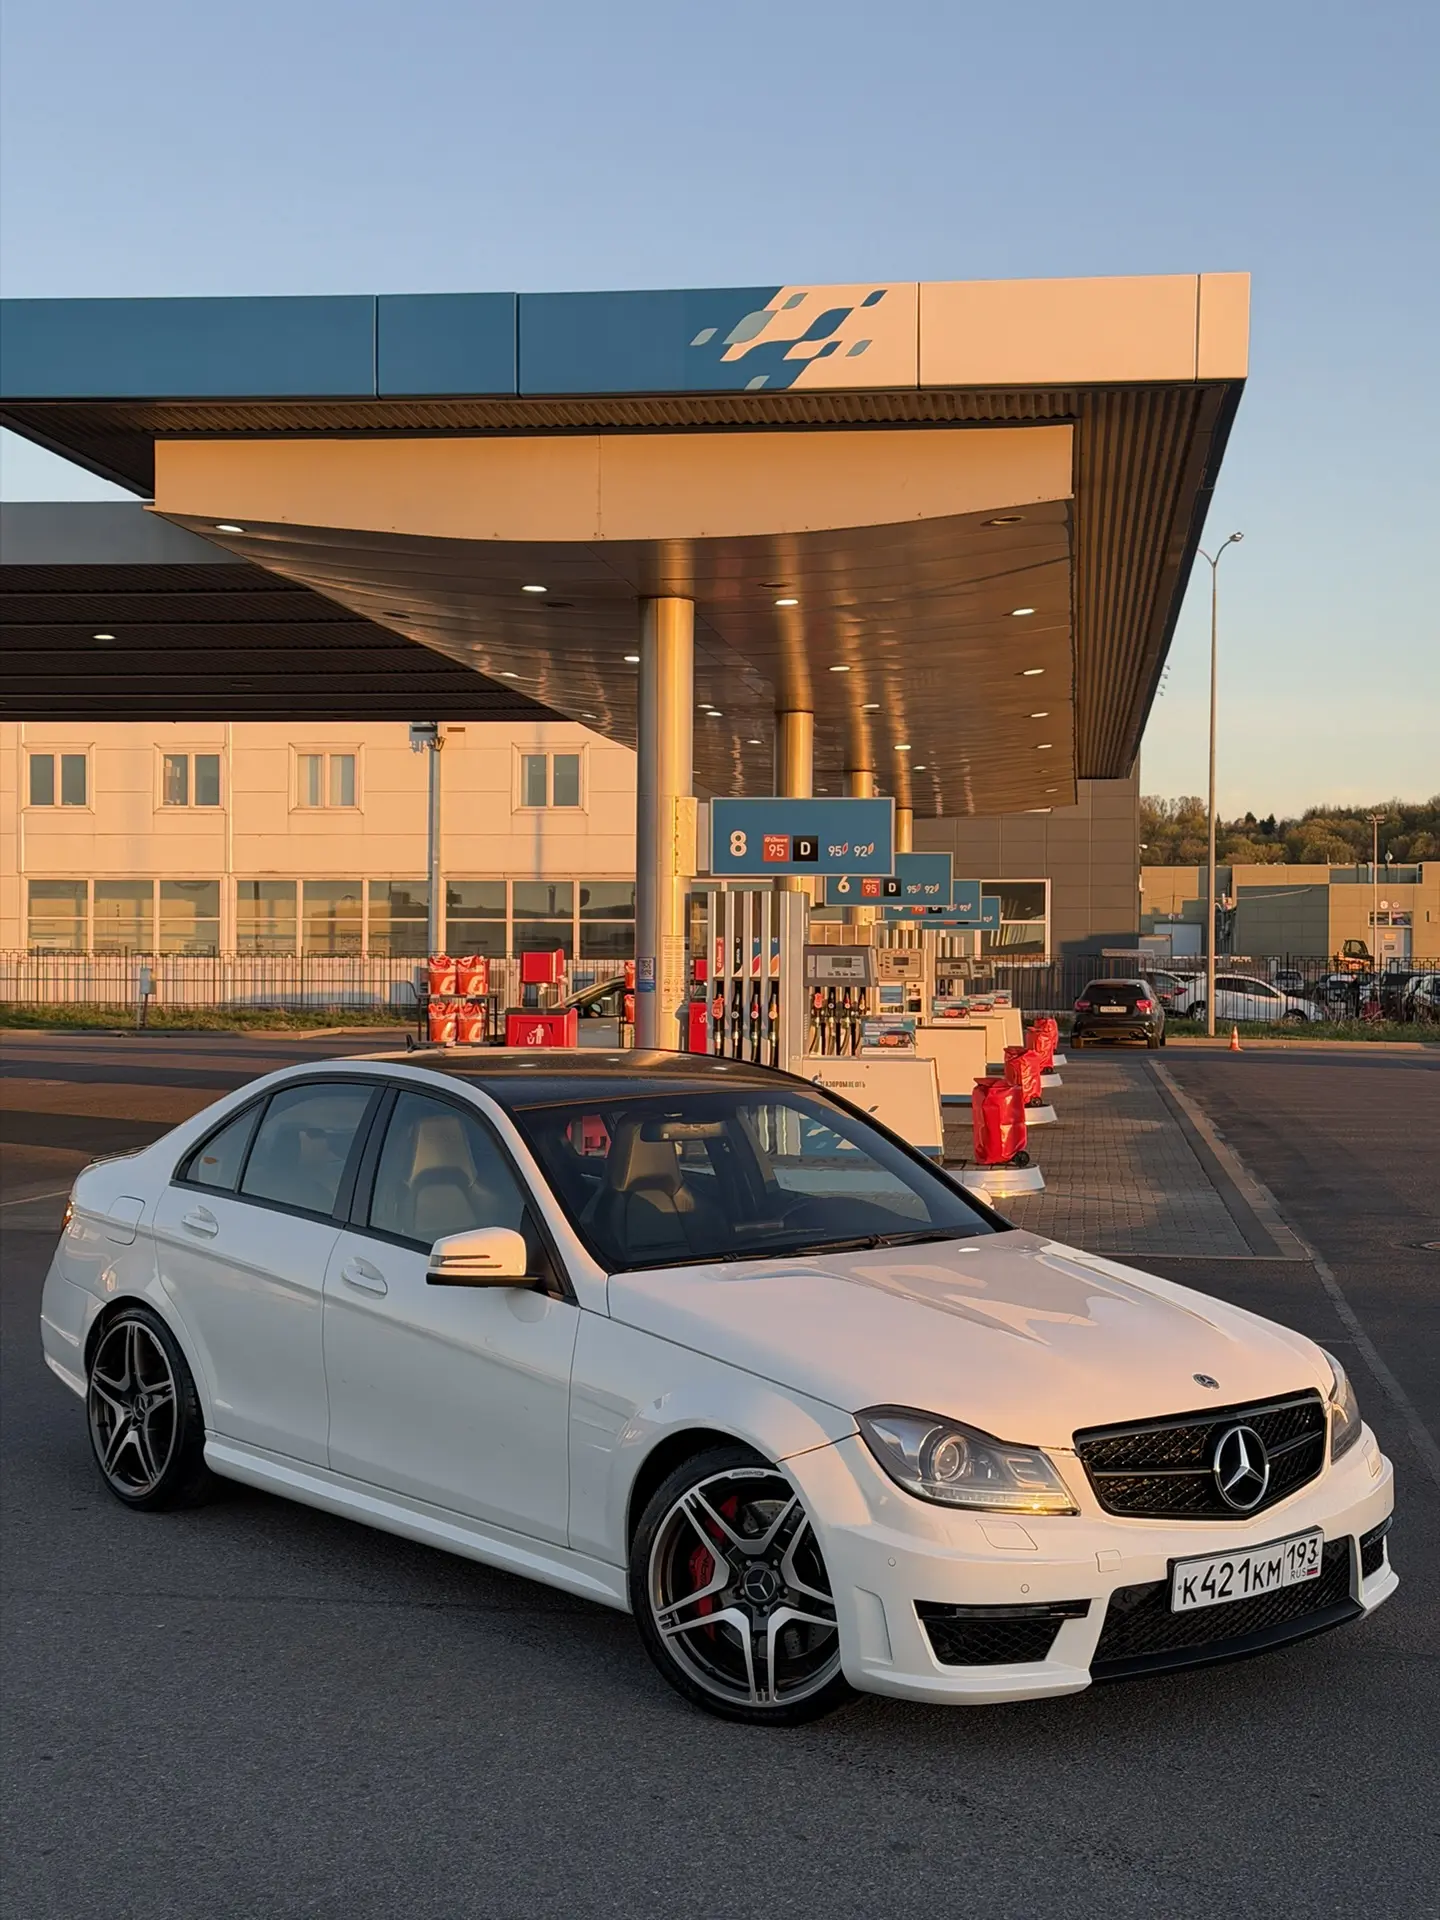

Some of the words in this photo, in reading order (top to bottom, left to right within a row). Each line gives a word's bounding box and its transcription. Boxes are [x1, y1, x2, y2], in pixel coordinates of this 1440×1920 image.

[730, 830, 747, 857] 8
[768, 843, 785, 857] 95
[800, 841, 811, 856] D
[828, 845, 842, 857] 95
[853, 845, 869, 857] 92
[837, 876, 851, 893] 6
[865, 884, 878, 894] 95
[888, 883, 897, 893] D
[906, 885, 916, 894] 95
[924, 885, 935, 894] 92
[1286, 1538, 1319, 1570] 193
[1290, 1567, 1307, 1581] RUS
